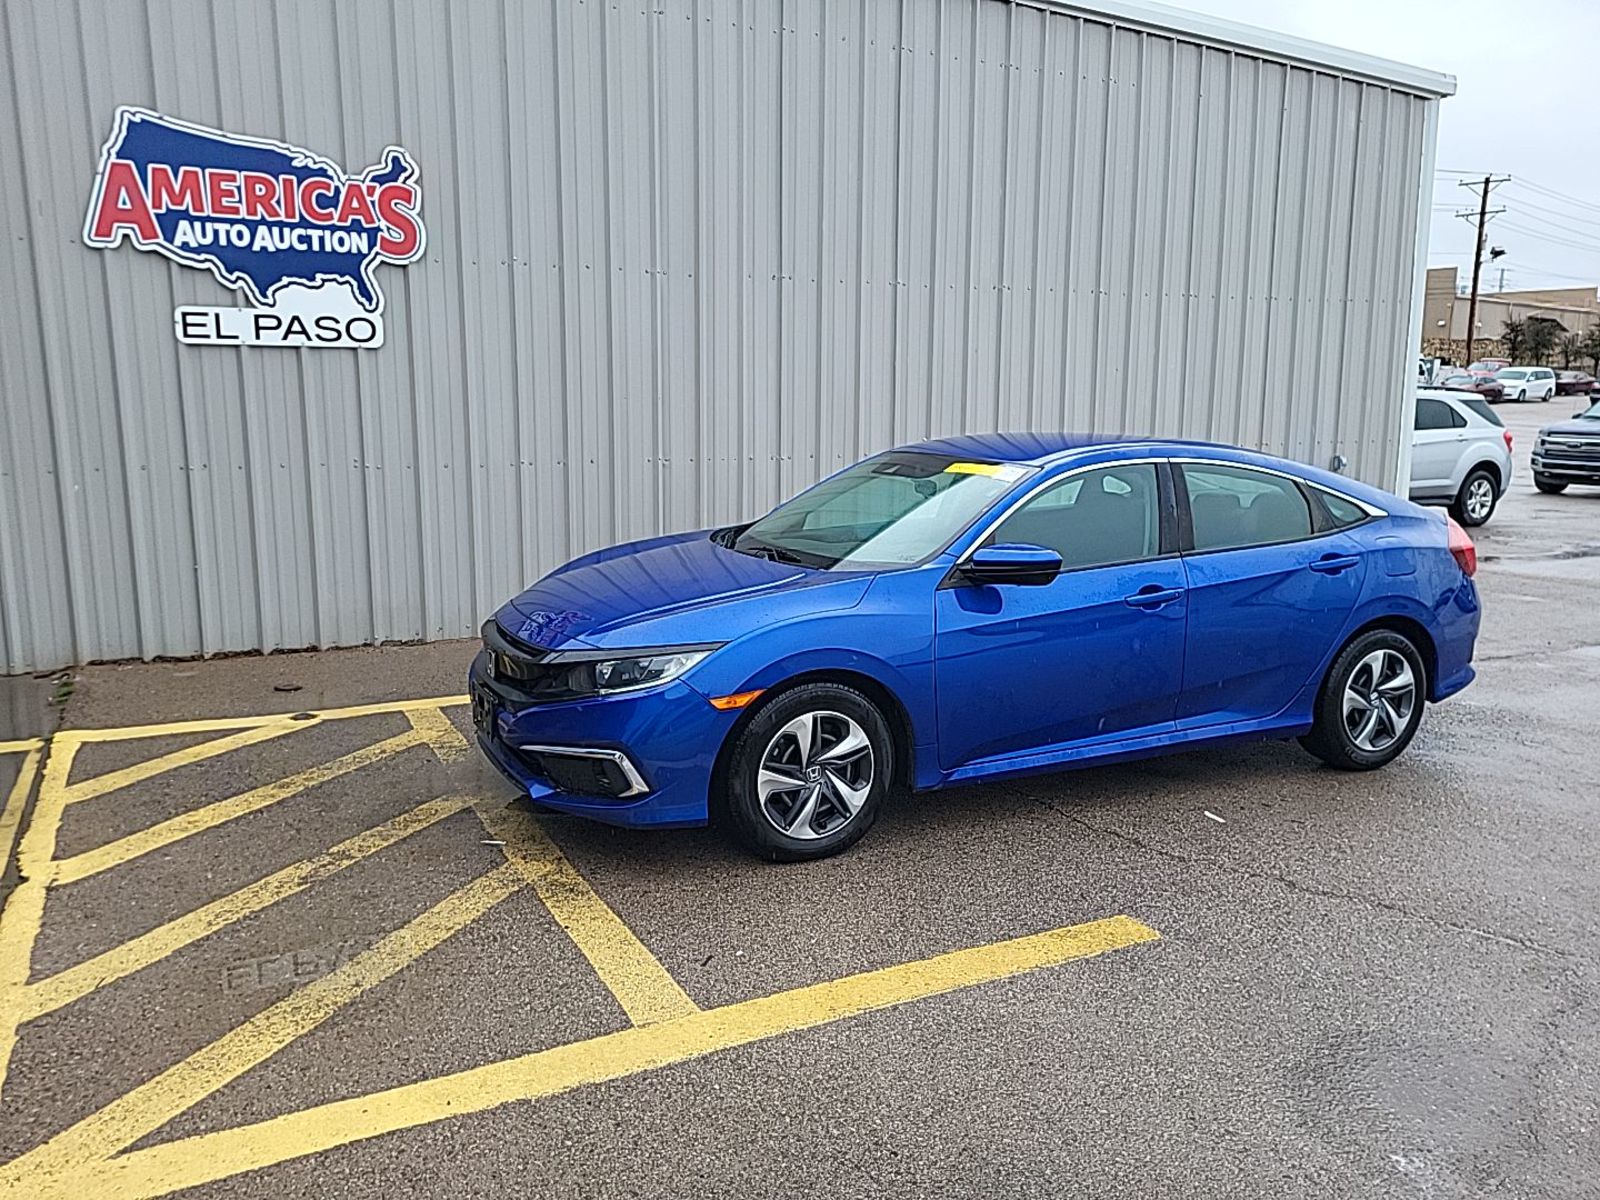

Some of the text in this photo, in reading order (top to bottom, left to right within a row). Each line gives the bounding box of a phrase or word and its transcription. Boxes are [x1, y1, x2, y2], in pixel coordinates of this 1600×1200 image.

[93, 160, 418, 257] AMERICA'S
[174, 219, 369, 254] AUTO AUCTION
[181, 311, 377, 343] EL PASO
